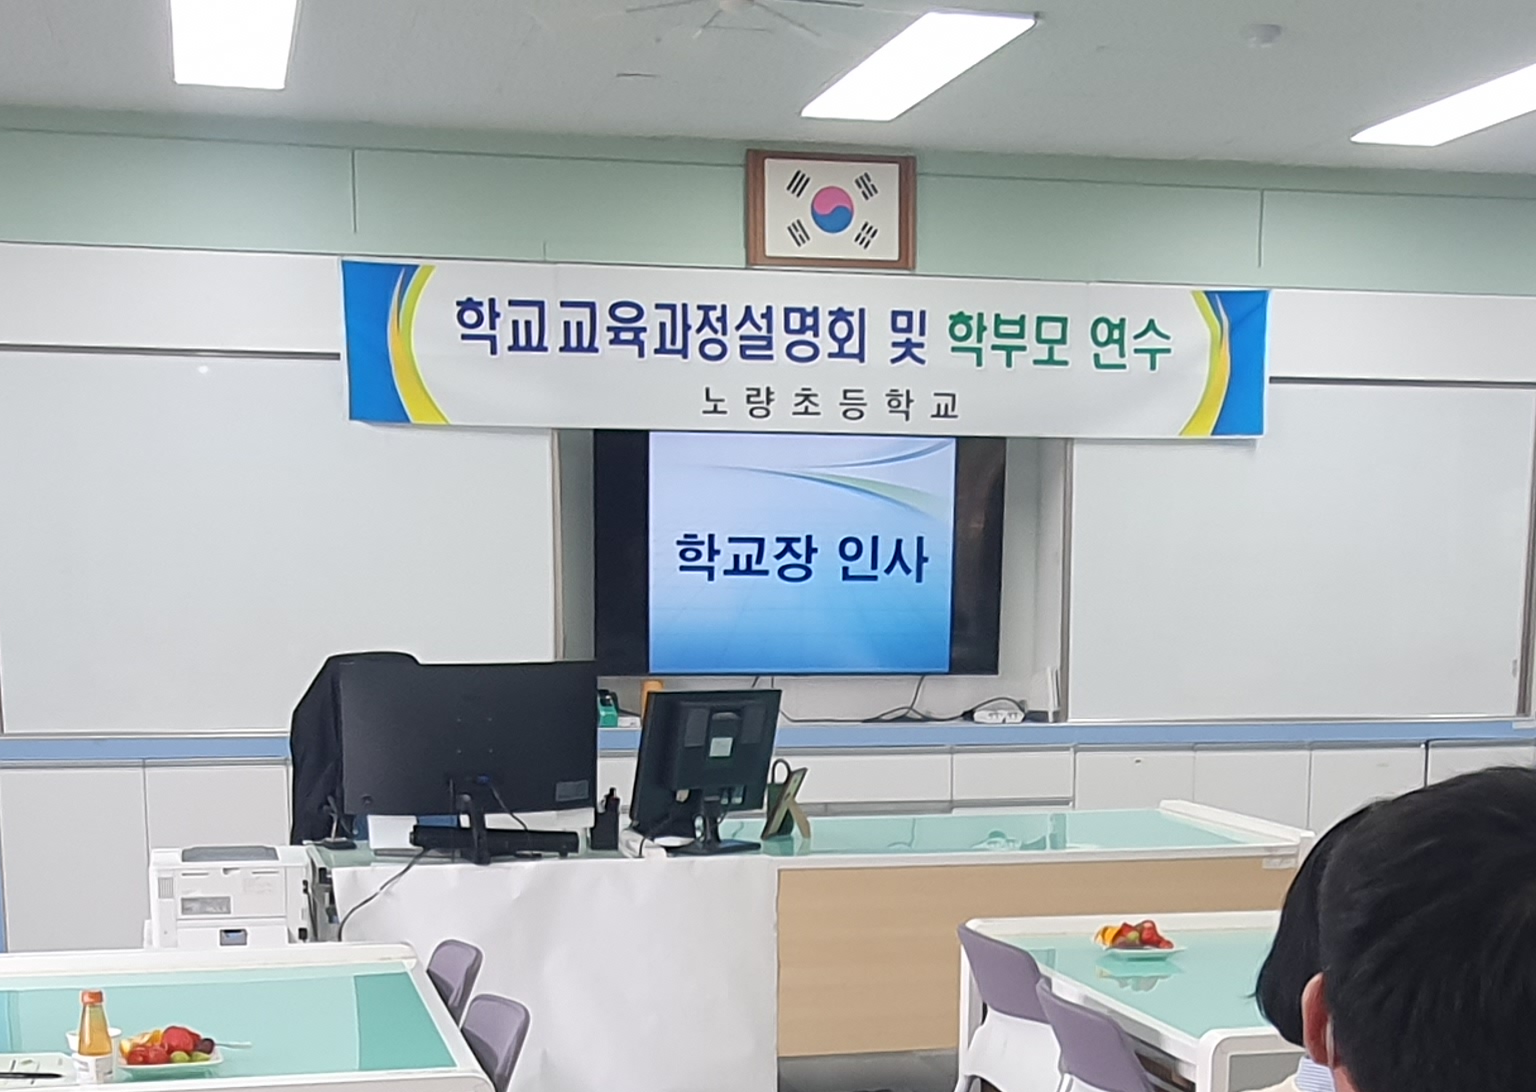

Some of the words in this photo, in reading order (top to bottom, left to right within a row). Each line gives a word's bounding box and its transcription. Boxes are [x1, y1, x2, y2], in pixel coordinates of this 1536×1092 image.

[891, 309, 927, 365] 및
[949, 311, 1069, 369] 학부모
[1091, 317, 1172, 370] 연수
[703, 386, 959, 422] 노량초등학교
[676, 533, 819, 583] 학교장
[838, 535, 929, 584] 인사
